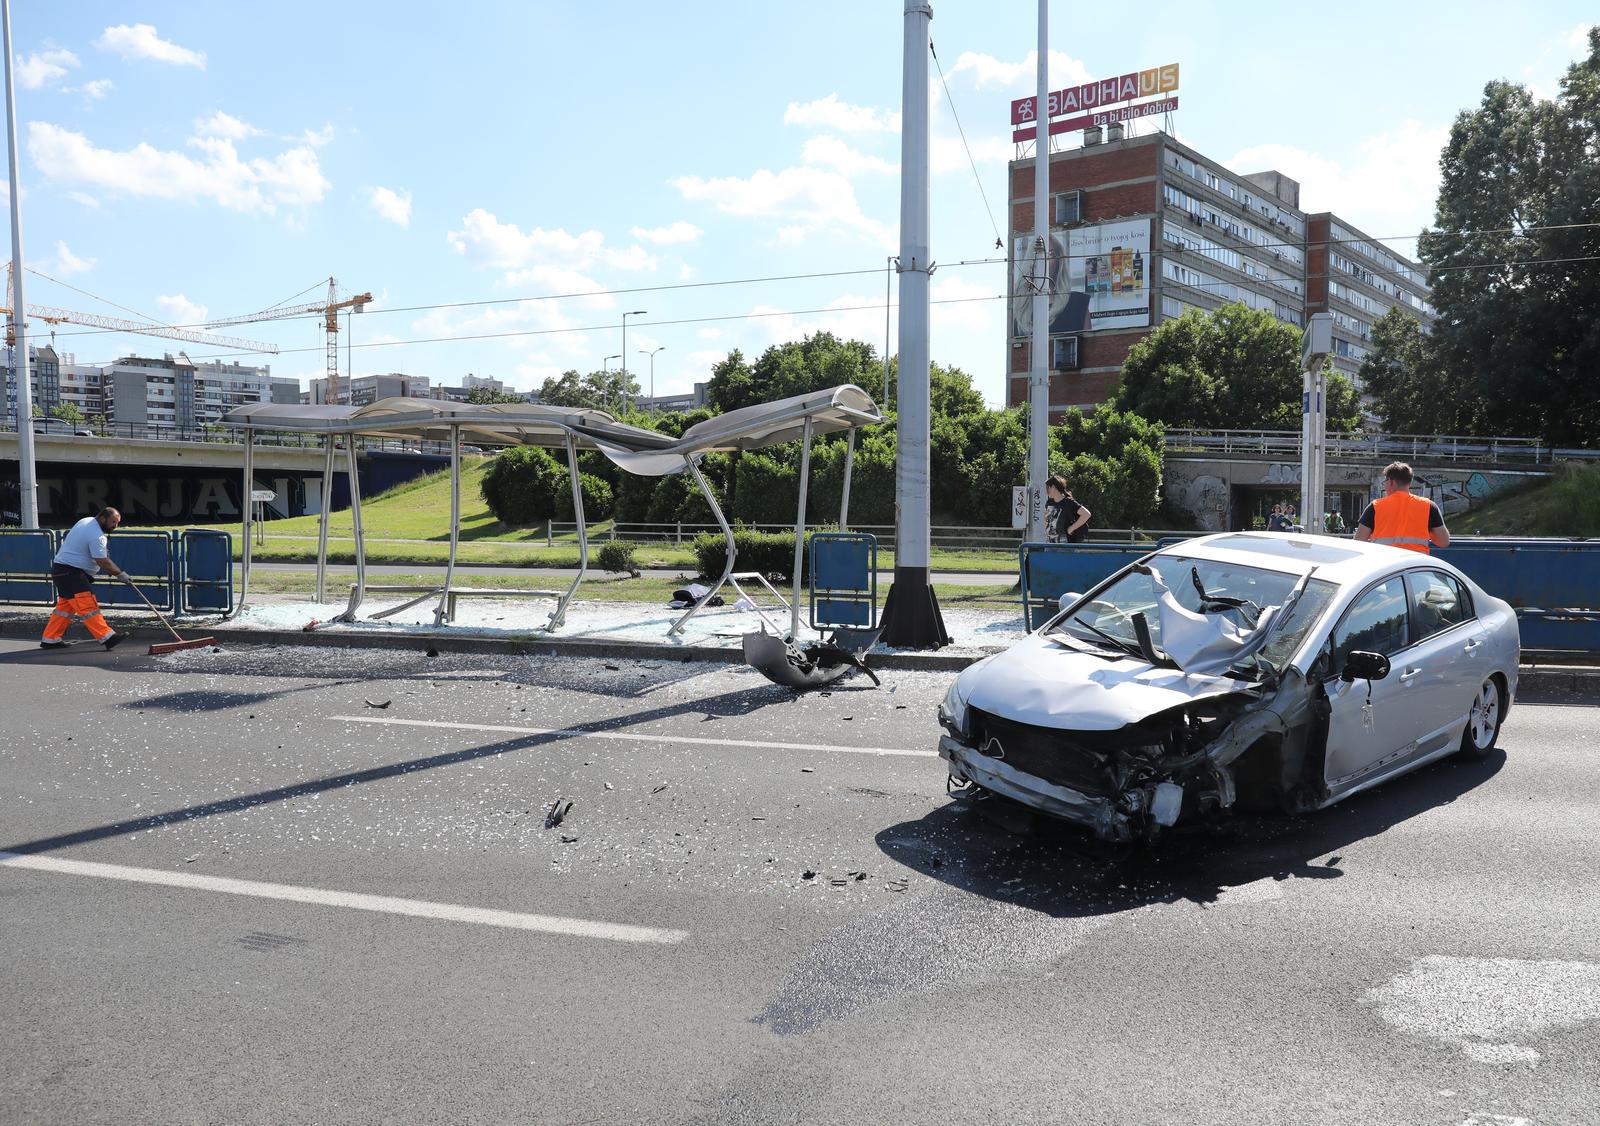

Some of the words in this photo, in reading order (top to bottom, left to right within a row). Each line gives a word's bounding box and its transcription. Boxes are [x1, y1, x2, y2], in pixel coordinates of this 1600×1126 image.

[1047, 67, 1177, 114] BAUHAUS
[1093, 113, 1107, 126] Da
[1109, 110, 1119, 123] bi
[1121, 106, 1140, 120] bilo
[1143, 101, 1177, 116] dobro.
